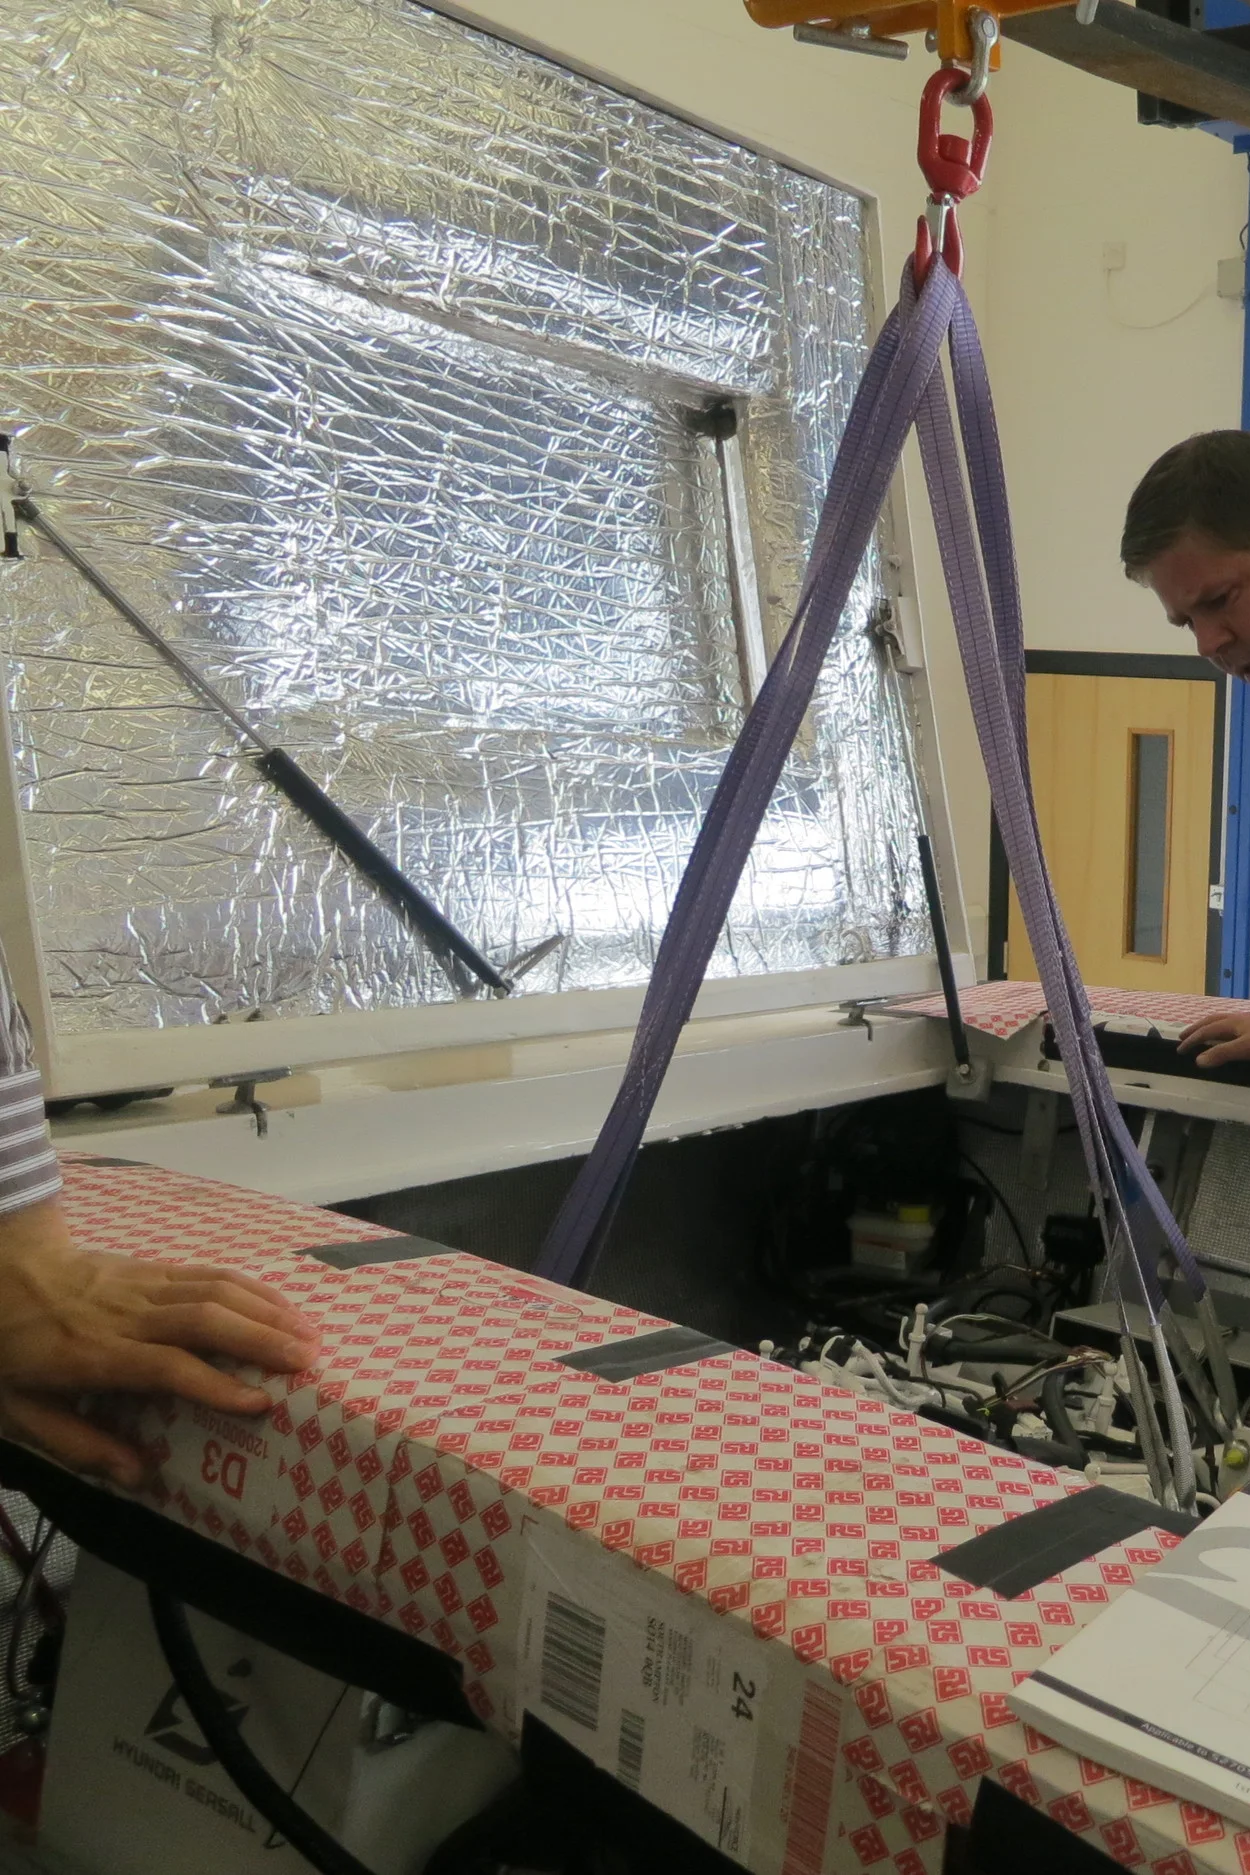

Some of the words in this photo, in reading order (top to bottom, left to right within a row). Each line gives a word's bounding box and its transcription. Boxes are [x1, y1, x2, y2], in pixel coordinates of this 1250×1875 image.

[341, 1334, 377, 1345] RS
[408, 1336, 444, 1346] RS
[576, 1332, 604, 1343] RS
[370, 1346, 402, 1359] RS
[697, 1356, 732, 1369] RS
[426, 1370, 457, 1382] RS
[496, 1372, 525, 1384] RS
[664, 1365, 699, 1377] RS
[634, 1374, 662, 1385] RS
[700, 1379, 725, 1390] RS
[661, 1387, 696, 1398] RS
[759, 1382, 793, 1393] RS
[560, 1395, 589, 1407] RS
[629, 1398, 657, 1410] RS
[728, 1392, 761, 1402] RS
[795, 1395, 821, 1407] RS
[696, 1400, 723, 1411] RS
[857, 1401, 884, 1412] RS
[588, 1409, 625, 1423] RS
[656, 1412, 693, 1424] RS
[725, 1414, 760, 1426] RS
[823, 1410, 857, 1421] RS
[890, 1413, 917, 1426] RS
[405, 1420, 439, 1437] RS
[551, 1421, 583, 1435] RS
[623, 1424, 652, 1437] RS
[790, 1418, 826, 1430] RS
[920, 1425, 957, 1437] RS
[297, 1417, 325, 1451] RS
[693, 1426, 721, 1439] RS
[761, 1429, 788, 1441] RS
[825, 1434, 857, 1445] RS
[510, 1434, 542, 1450] RS
[580, 1439, 617, 1450] RS
[652, 1440, 688, 1451] RS
[722, 1443, 757, 1454] RS
[894, 1437, 920, 1450] RS
[958, 1440, 987, 1454] RS
[795, 1444, 822, 1457] RS
[863, 1449, 889, 1462] RS
[354, 1449, 382, 1482] RS
[465, 1452, 503, 1471] RS
[539, 1453, 577, 1465] RS
[616, 1453, 646, 1467] RS
[688, 1455, 717, 1470] RS
[756, 1459, 791, 1471] RS
[825, 1460, 861, 1471] RS
[990, 1456, 1032, 1468] RS
[202, 1439, 247, 1500] D3
[574, 1468, 607, 1484] RS
[646, 1470, 683, 1483] RS
[963, 1466, 992, 1479] RS
[1029, 1467, 1059, 1486] RS
[415, 1465, 444, 1500] RS
[500, 1467, 532, 1493] RS
[722, 1471, 751, 1487] RS
[794, 1474, 823, 1489] RS
[864, 1474, 893, 1490] RS
[934, 1480, 962, 1492] RS
[605, 1487, 643, 1499] RS
[680, 1487, 718, 1500] RS
[753, 1490, 791, 1501] RS
[997, 1482, 1032, 1496] RS
[826, 1492, 863, 1504] RS
[897, 1492, 933, 1505] RS
[967, 1496, 1005, 1509] RS
[565, 1502, 599, 1530] RS
[638, 1503, 678, 1517] RS
[719, 1504, 750, 1520] RS
[794, 1505, 823, 1521] RS
[867, 1507, 897, 1524] RS
[482, 1502, 511, 1538] RS
[938, 1509, 968, 1526] RS
[408, 1510, 436, 1549] RS
[602, 1521, 635, 1551] RS
[678, 1521, 711, 1538] RS
[752, 1522, 790, 1536] RS
[828, 1524, 865, 1538] RS
[901, 1528, 939, 1541] RS
[439, 1530, 469, 1566] RS
[711, 1540, 751, 1555] RS
[793, 1539, 824, 1555] RS
[869, 1542, 899, 1558] RS
[631, 1542, 673, 1567] RS
[1125, 1548, 1163, 1564] RS
[475, 1548, 503, 1587] RS
[753, 1557, 786, 1578] RS
[828, 1559, 867, 1576] RS
[908, 1561, 941, 1580] RS
[1100, 1564, 1135, 1585] RS
[675, 1559, 707, 1594] RS
[433, 1573, 462, 1615] RS
[788, 1580, 829, 1598] RS
[867, 1582, 907, 1596] RS
[1066, 1585, 1109, 1602] RS
[709, 1583, 749, 1614] RS
[468, 1597, 498, 1631] RS
[828, 1601, 869, 1619] RS
[960, 1602, 1001, 1619] RS
[1038, 1602, 1074, 1625] RS
[752, 1602, 785, 1639] RS
[929, 1621, 962, 1643] RS
[1006, 1623, 1042, 1646] RS
[793, 1624, 826, 1663] RS
[885, 1646, 929, 1672] RS
[968, 1647, 1010, 1667] RS
[935, 1668, 971, 1701] RS
[731, 1671, 756, 1722] 24
[857, 1682, 892, 1728] RS
[900, 1708, 942, 1751] RS
[1140, 1721, 1195, 1750] Applicable
[1196, 1745, 1208, 1758] to
[948, 1735, 991, 1779] RS
[112, 1735, 181, 1791] HYUNDAI
[184, 1777, 257, 1834] SEASALL
[1181, 1801, 1225, 1845] RS
